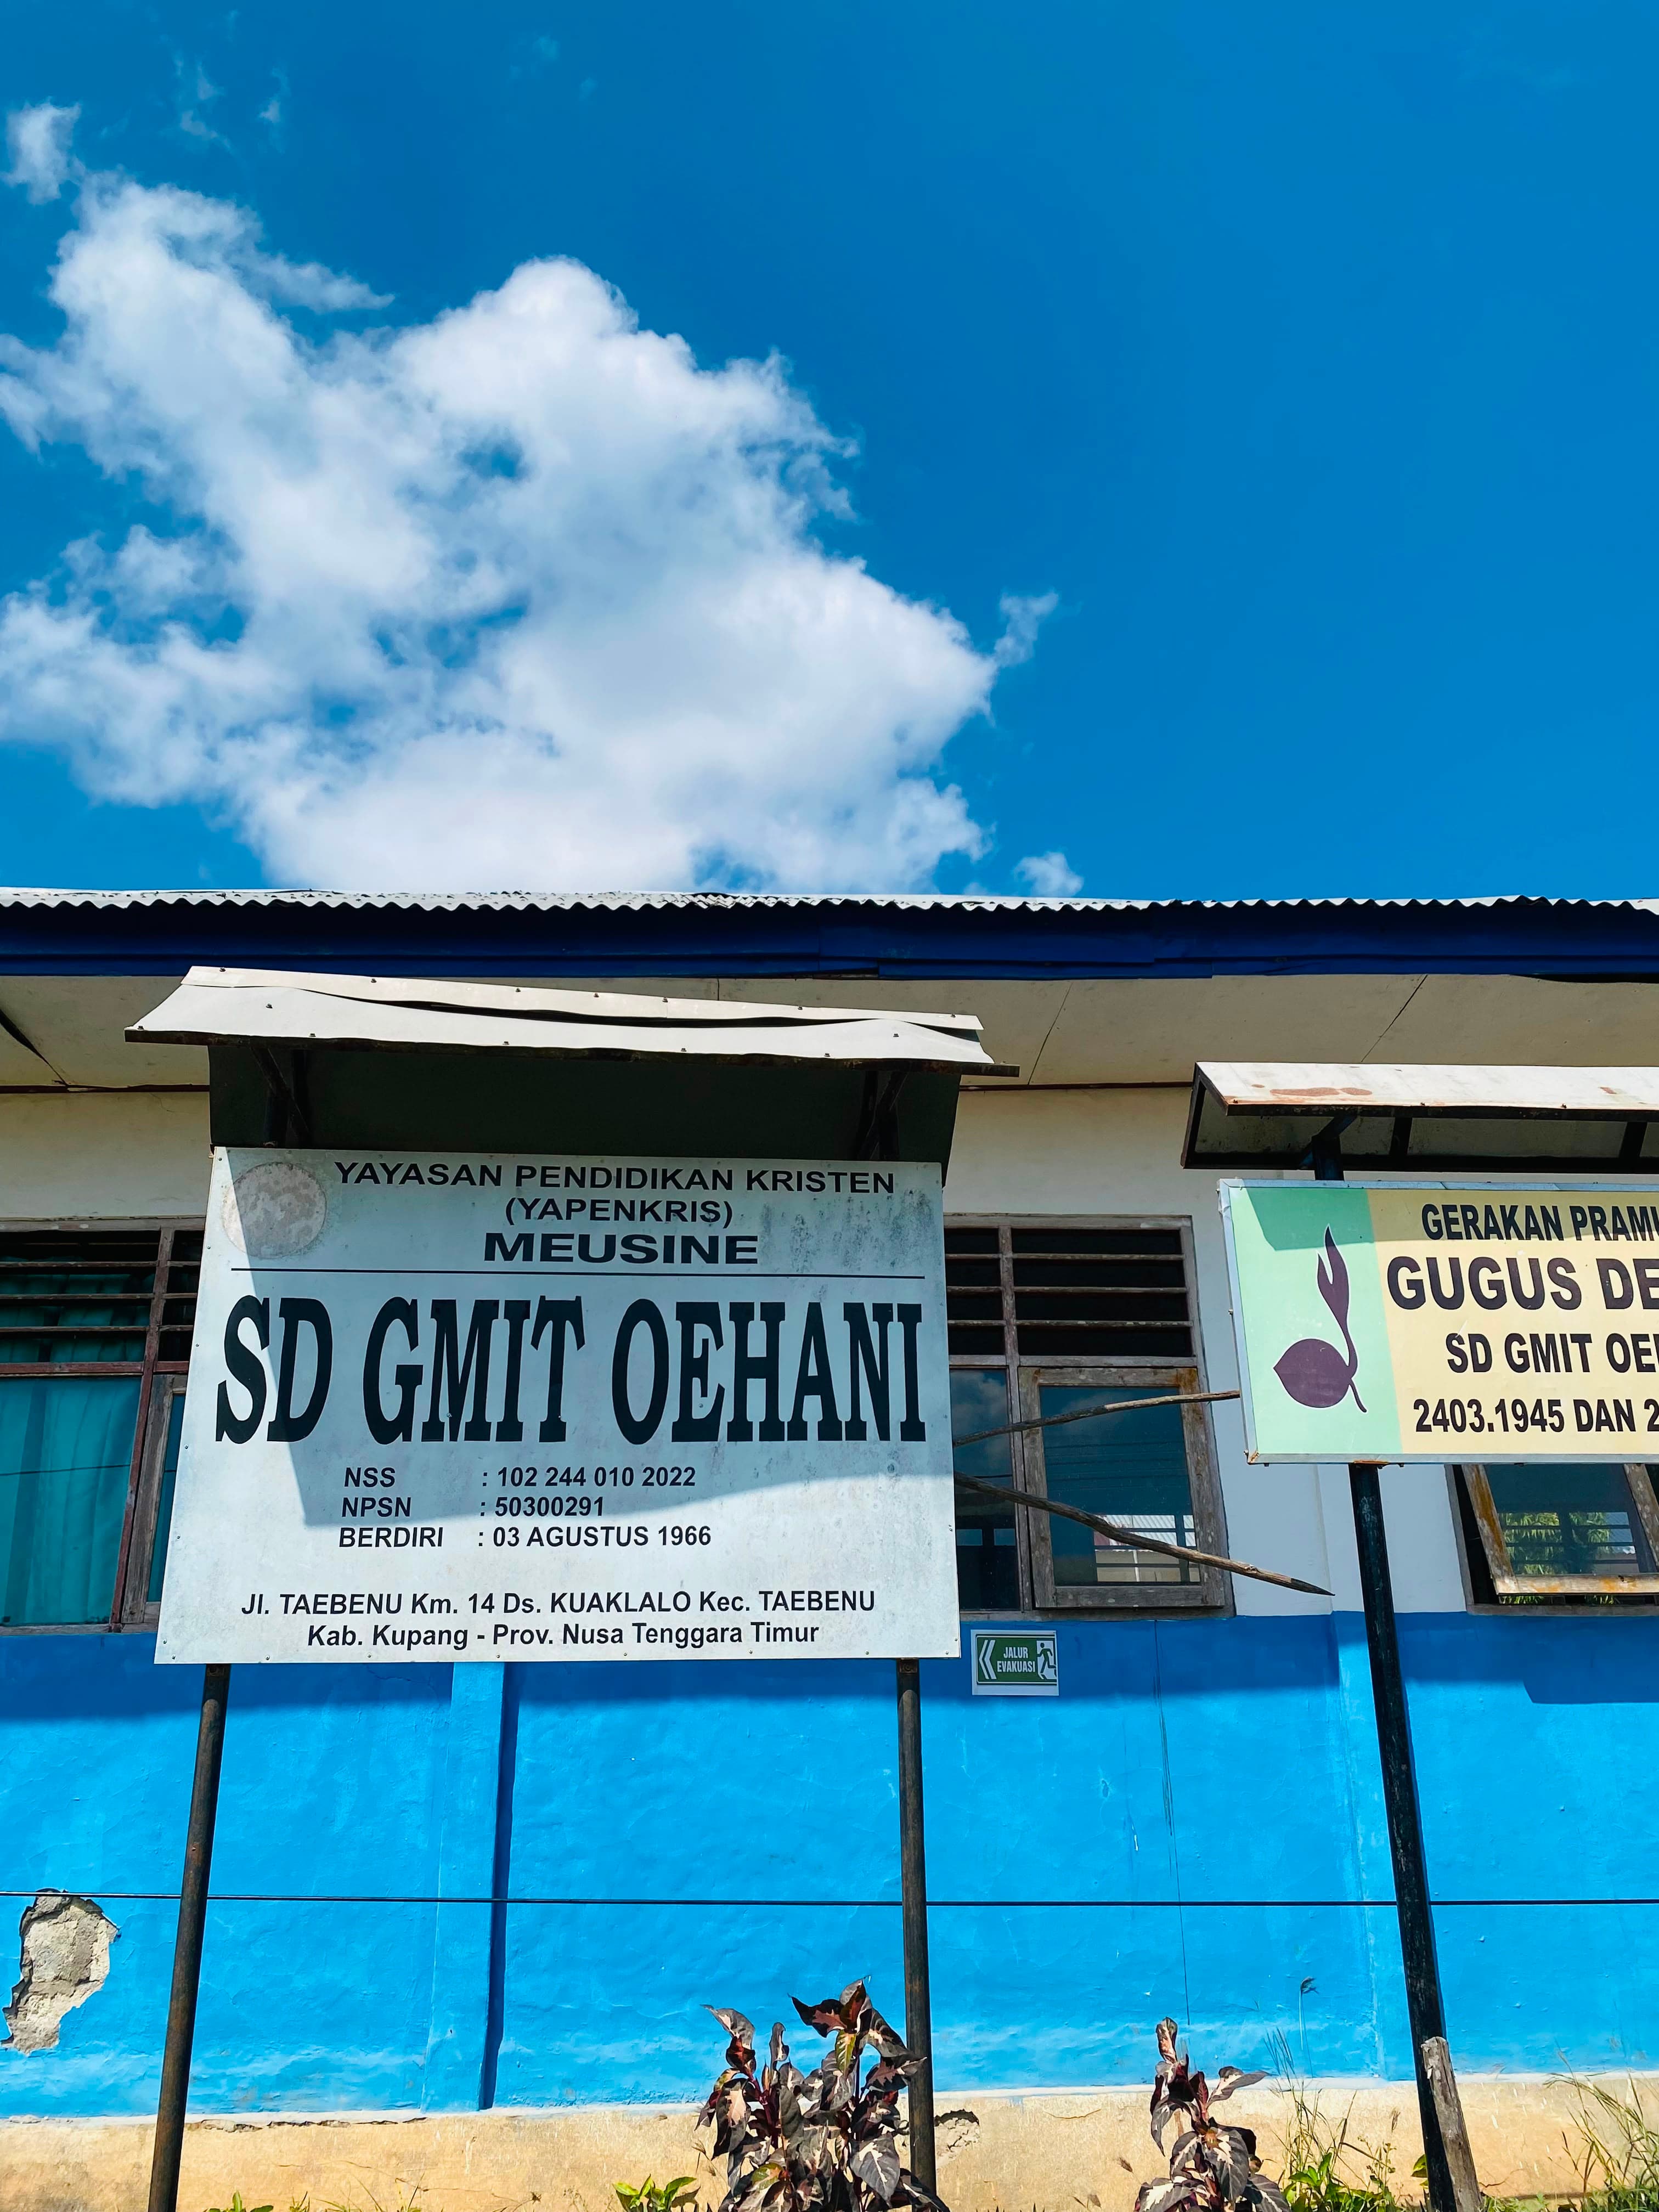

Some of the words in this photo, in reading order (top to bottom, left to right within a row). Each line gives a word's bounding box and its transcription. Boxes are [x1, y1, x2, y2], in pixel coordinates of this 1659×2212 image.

[334, 1161, 503, 1187] YAYASAN
[515, 1165, 733, 1191] PENDIDIKAN
[746, 1169, 895, 1194] KRISTEN
[506, 1197, 733, 1229] (YAPENKRIS)
[1421, 1204, 1564, 1242] GERAKAN
[484, 1232, 759, 1265] MEUSINE
[1387, 1256, 1582, 1310] GUGUS
[1595, 1257, 1659, 1310] DE
[1446, 1333, 1493, 1373] SD
[1504, 1333, 1593, 1373] GMIT
[1606, 1333, 1659, 1373] OE
[215, 1295, 333, 1445] SD
[363, 1295, 585, 1446] GMIT
[612, 1298, 927, 1446] OEHANI
[1413, 1398, 1565, 1433] 2403.1945
[1573, 1399, 1637, 1432] DAN
[344, 1466, 396, 1488] NSS
[498, 1466, 538, 1487] 102
[545, 1466, 586, 1487] 244
[594, 1466, 634, 1487] 010
[641, 1466, 696, 1487] 2022
[341, 1497, 411, 1517] NPSN
[495, 1496, 603, 1517] 50300291
[339, 1527, 443, 1548] BERDIRI
[493, 1527, 520, 1547] 03
[527, 1526, 649, 1547] AGUSTUS
[658, 1526, 712, 1546] 1966
[280, 1593, 403, 1615] TAEBENU
[411, 1593, 458, 1614] Km.
[469, 1593, 495, 1613] 14
[504, 1593, 541, 1613] Ds.
[551, 1592, 691, 1613] KUAKLALO
[700, 1591, 751, 1611] Kec.
[758, 1590, 875, 1611] TAEBENU
[308, 1625, 363, 1646] Kab.
[373, 1624, 469, 1651] Kupang
[493, 1624, 554, 1645] Prov.
[563, 1623, 624, 1644] Nusa
[631, 1622, 743, 1649] Tenggara
[750, 1622, 820, 1643] Timur
[1003, 1646, 1029, 1658] JALUR
[997, 1661, 1036, 1673] EVAKUASI
